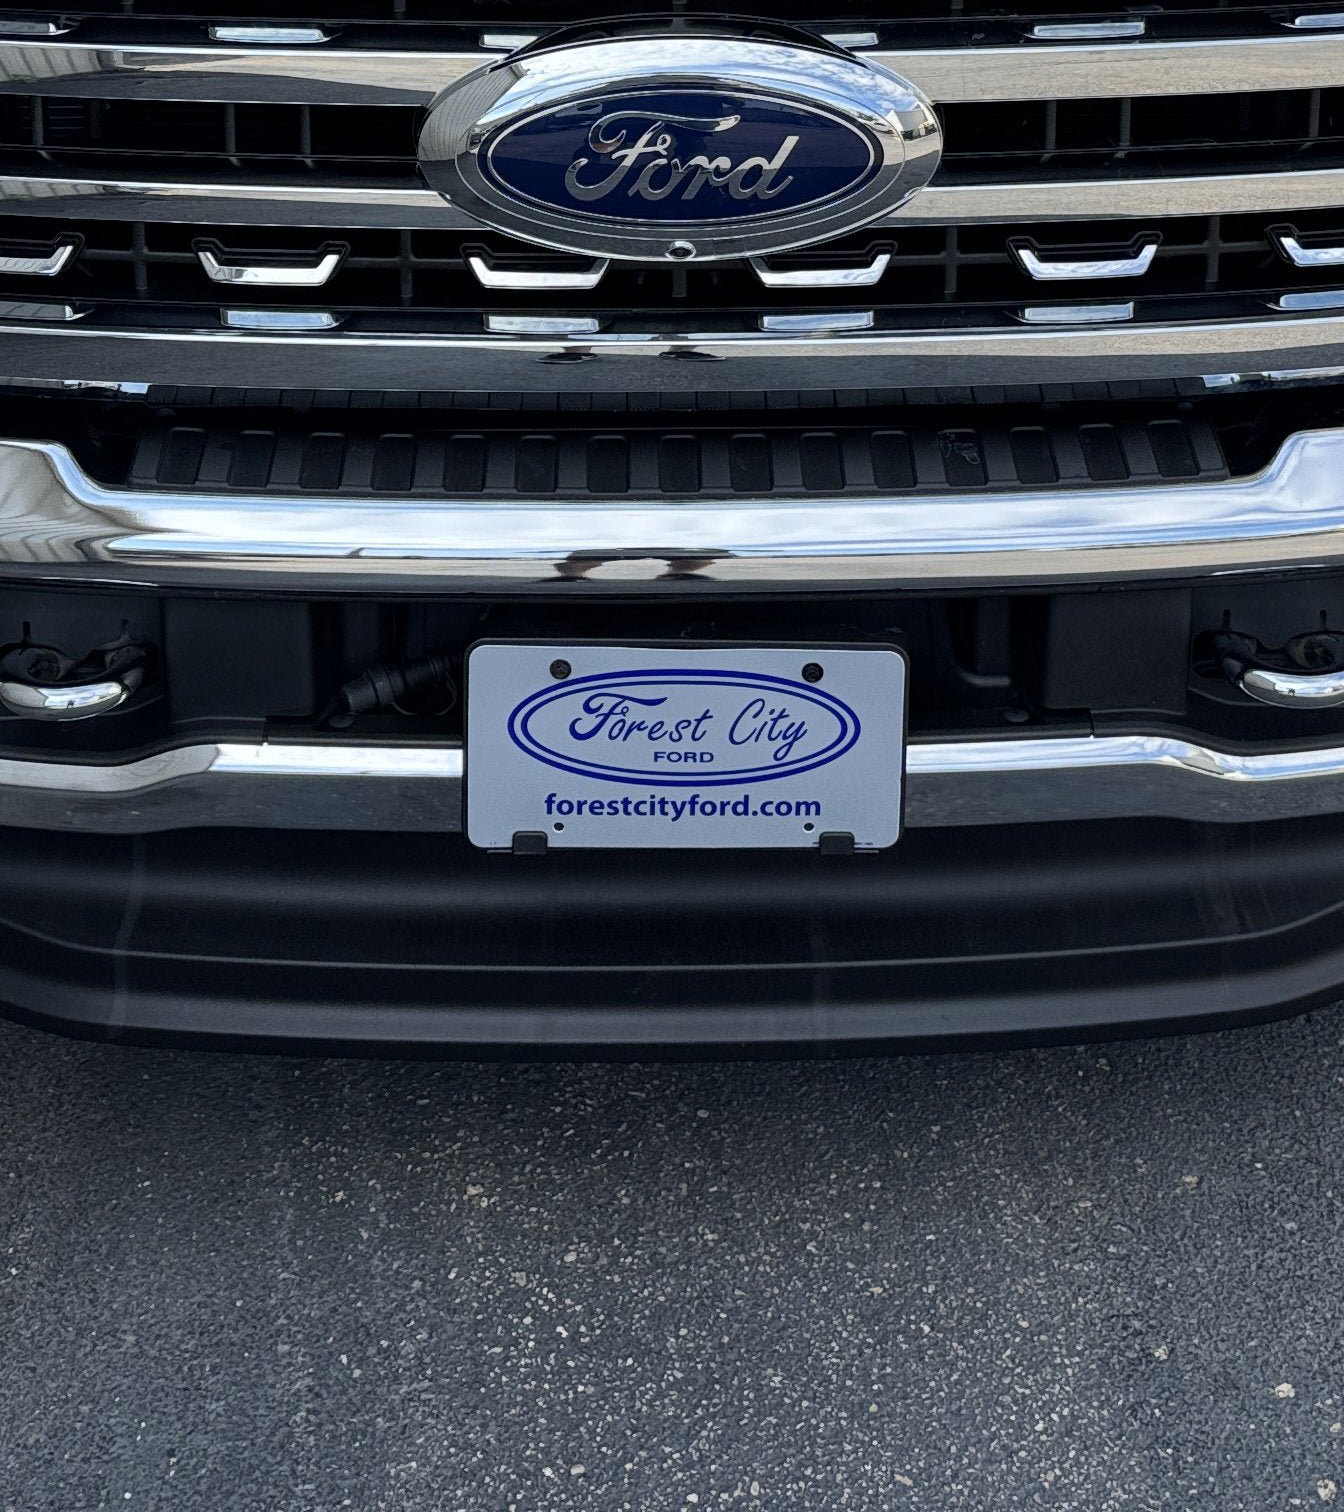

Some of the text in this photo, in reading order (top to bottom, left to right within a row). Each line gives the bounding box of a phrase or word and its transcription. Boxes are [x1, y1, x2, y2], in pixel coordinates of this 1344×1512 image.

[563, 110, 799, 203] Ford
[568, 692, 808, 761] Forest City
[652, 750, 716, 765] FORD
[543, 792, 823, 823] forestcityford.com
